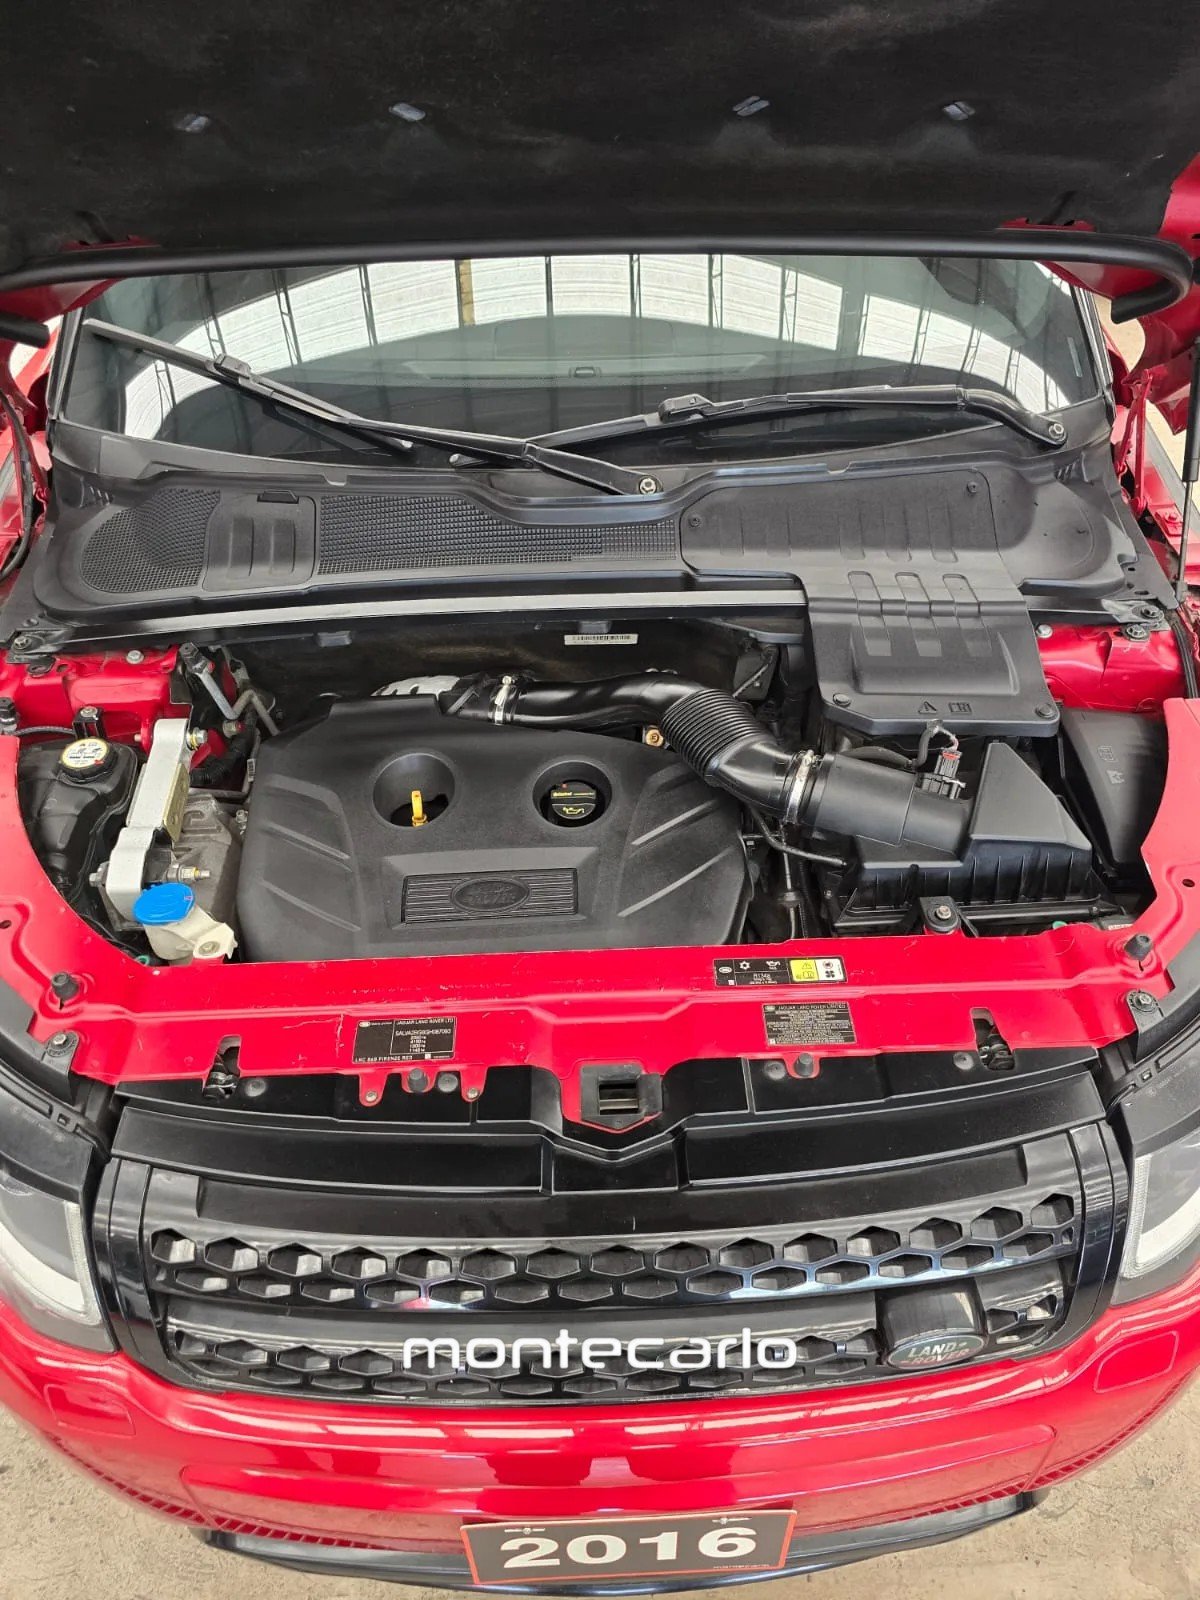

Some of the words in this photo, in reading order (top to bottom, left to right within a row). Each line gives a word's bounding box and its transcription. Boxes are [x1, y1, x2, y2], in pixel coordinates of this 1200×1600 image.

[907, 1341, 957, 1358] LAND
[911, 1348, 970, 1365] ROVER
[500, 1527, 757, 1568] 2016
